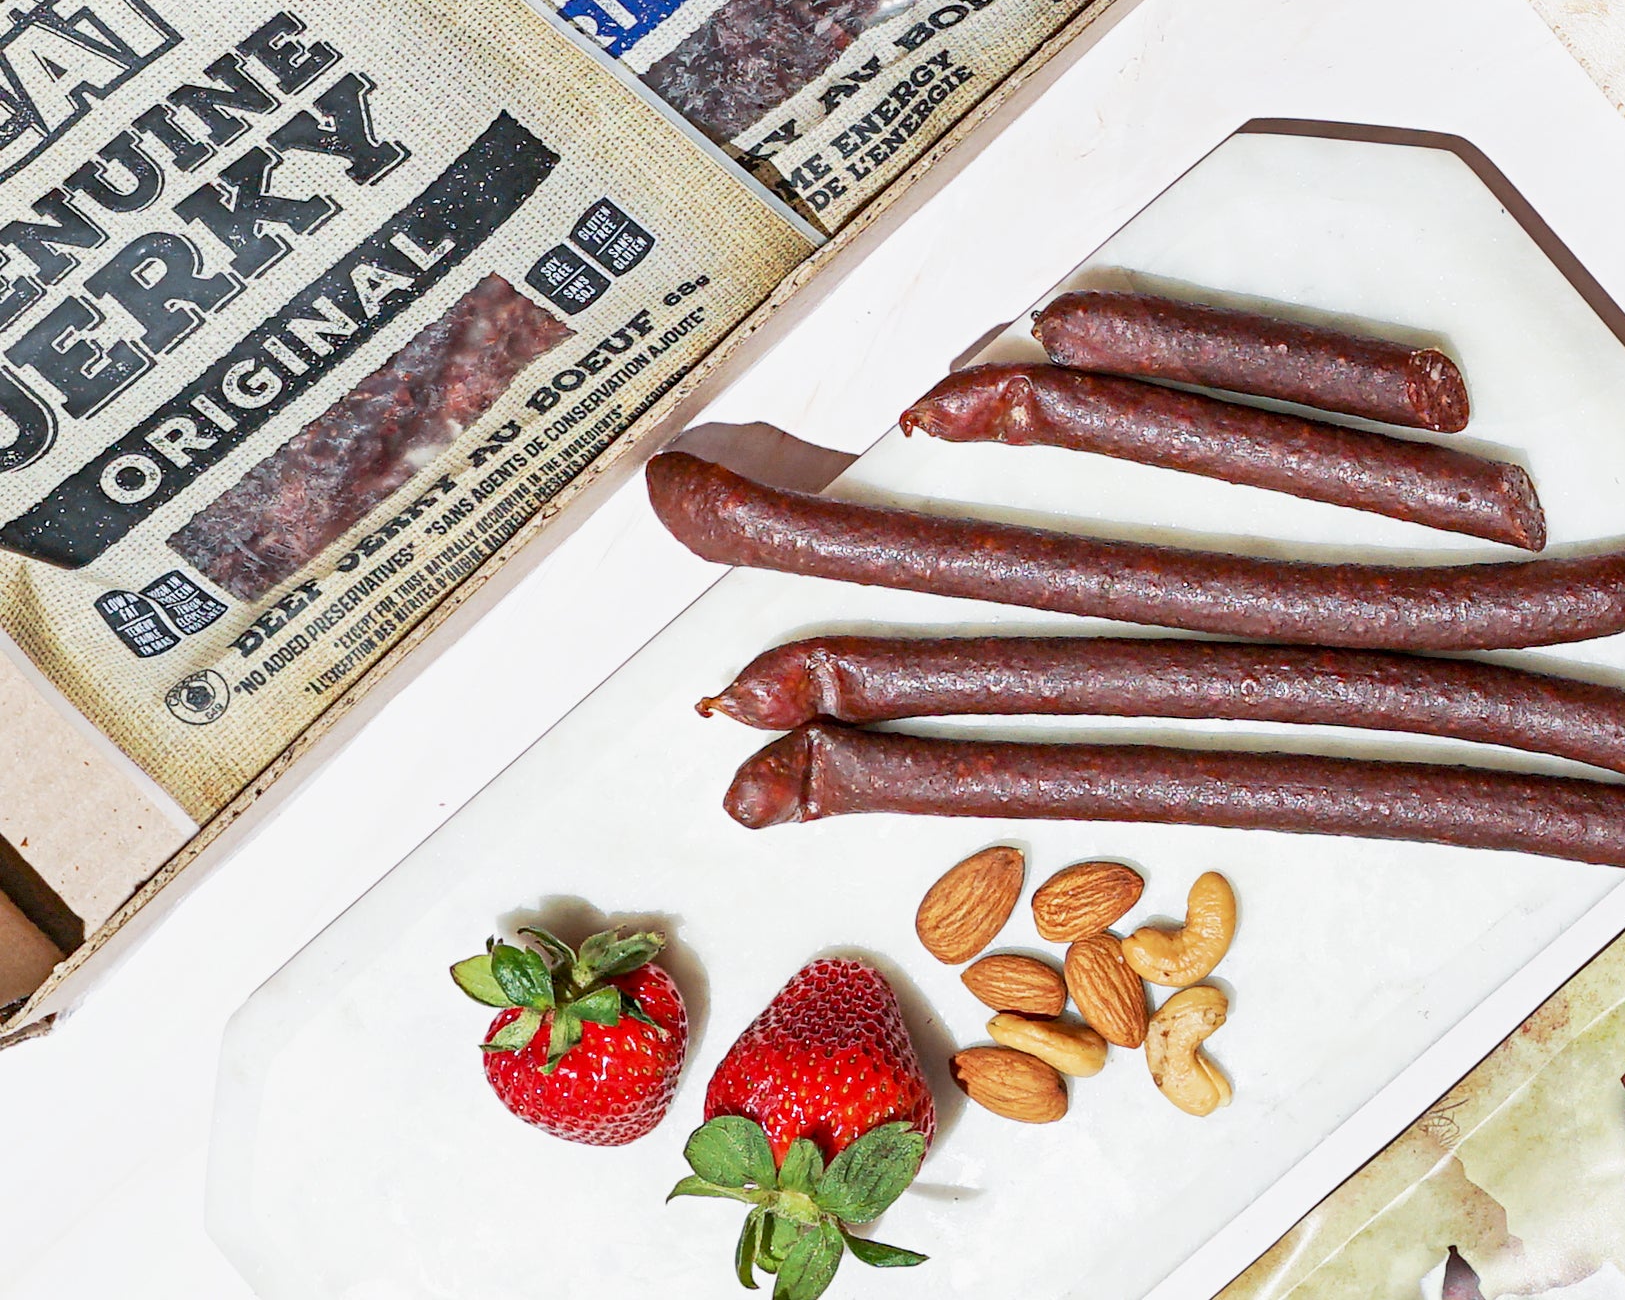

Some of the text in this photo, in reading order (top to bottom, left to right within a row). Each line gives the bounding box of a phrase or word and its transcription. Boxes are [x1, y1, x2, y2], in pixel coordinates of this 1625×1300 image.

[816, 55, 887, 114] AU
[830, 48, 957, 160] ENERGY
[806, 61, 976, 214] DE L'ENERGIE
[577, 203, 611, 242] GLUTEN
[592, 217, 618, 244] FREE
[607, 230, 634, 259] SANS
[612, 234, 648, 272] GLUTEN
[539, 255, 562, 278] SOY
[548, 261, 574, 286] FREE
[562, 273, 590, 300] SANS
[92, 208, 457, 517] ORIGINAL
[228, 575, 326, 662] BEEF
[466, 417, 524, 468] AU
[524, 307, 658, 419] BOEUF
[661, 269, 711, 309] 68g
[262, 632, 310, 677] ADDED
[470, 451, 528, 503] AGENTS
[523, 433, 549, 459] DE
[542, 350, 652, 444] CONSERVATION
[373, 593, 399, 619] FOR
[393, 569, 427, 602] THOSE
[424, 527, 478, 577] NATURALLY
[475, 481, 531, 535] OCCURRING
[526, 470, 542, 487] IN
[539, 455, 561, 477] THE
[374, 617, 398, 642] DES
[393, 581, 439, 624] NITRITES
[435, 543, 487, 590] D'ORIGINE
[481, 495, 540, 552] NATURELLE
[101, 592, 128, 615] LOW
[118, 602, 140, 623] FAT
